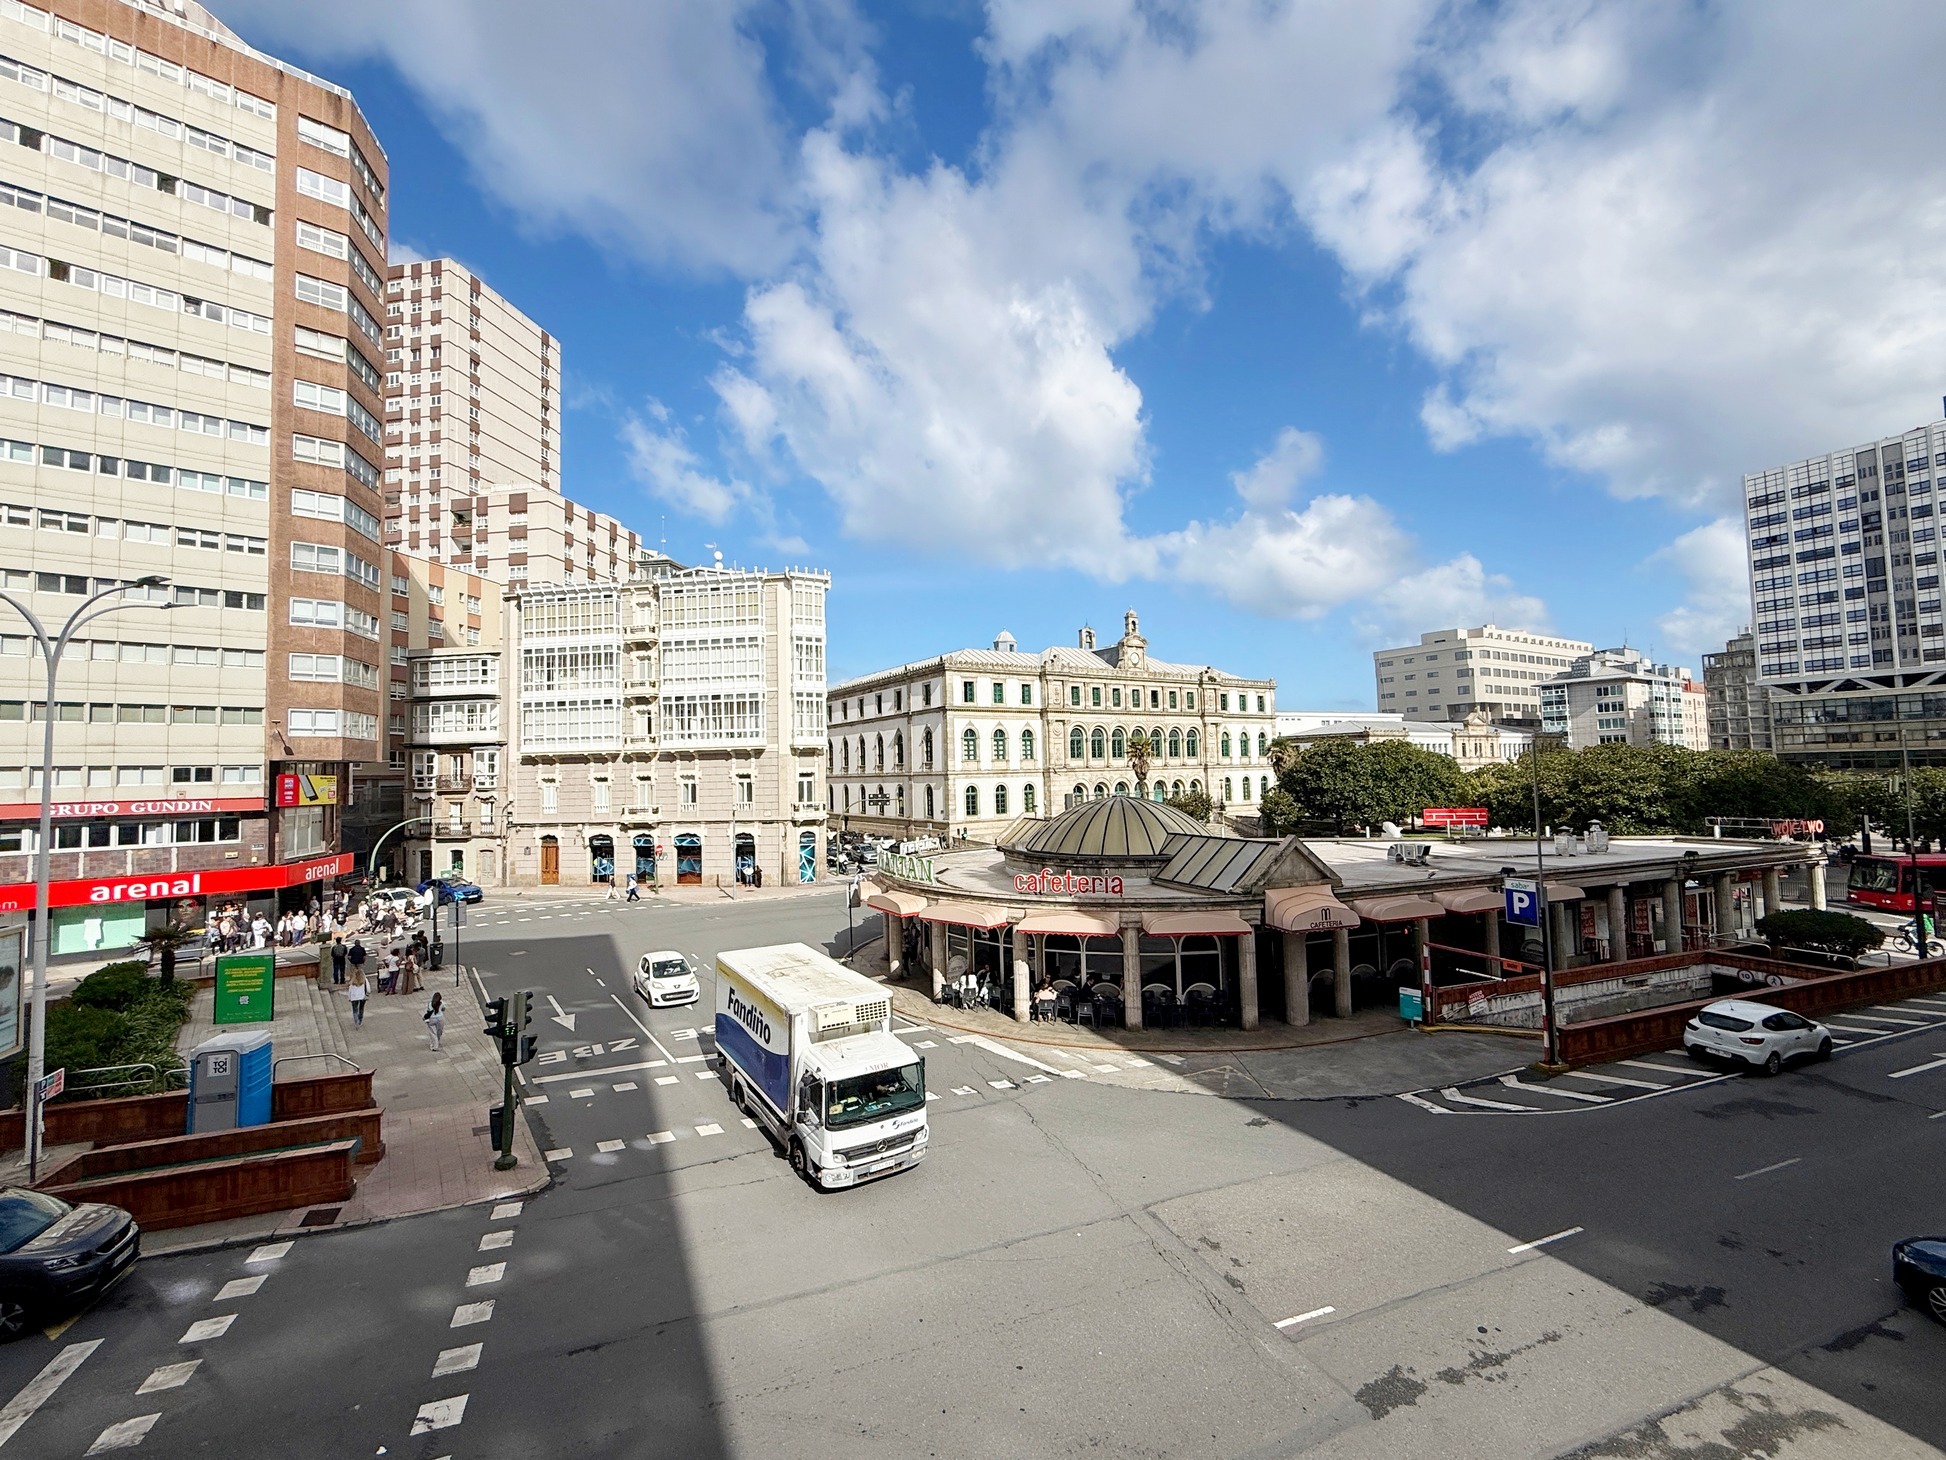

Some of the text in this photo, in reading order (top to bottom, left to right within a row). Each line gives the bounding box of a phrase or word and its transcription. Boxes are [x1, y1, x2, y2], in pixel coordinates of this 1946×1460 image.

[50, 800, 214, 816] GRUPO GUNDIN
[305, 857, 339, 880] arenal
[90, 874, 201, 901] arenal
[1013, 868, 1124, 895] cafeteria
[1512, 891, 1530, 915] P
[1310, 920, 1343, 928] CAFETERIA
[1741, 972, 1750, 980] 10
[726, 986, 771, 1045] Fandiño
